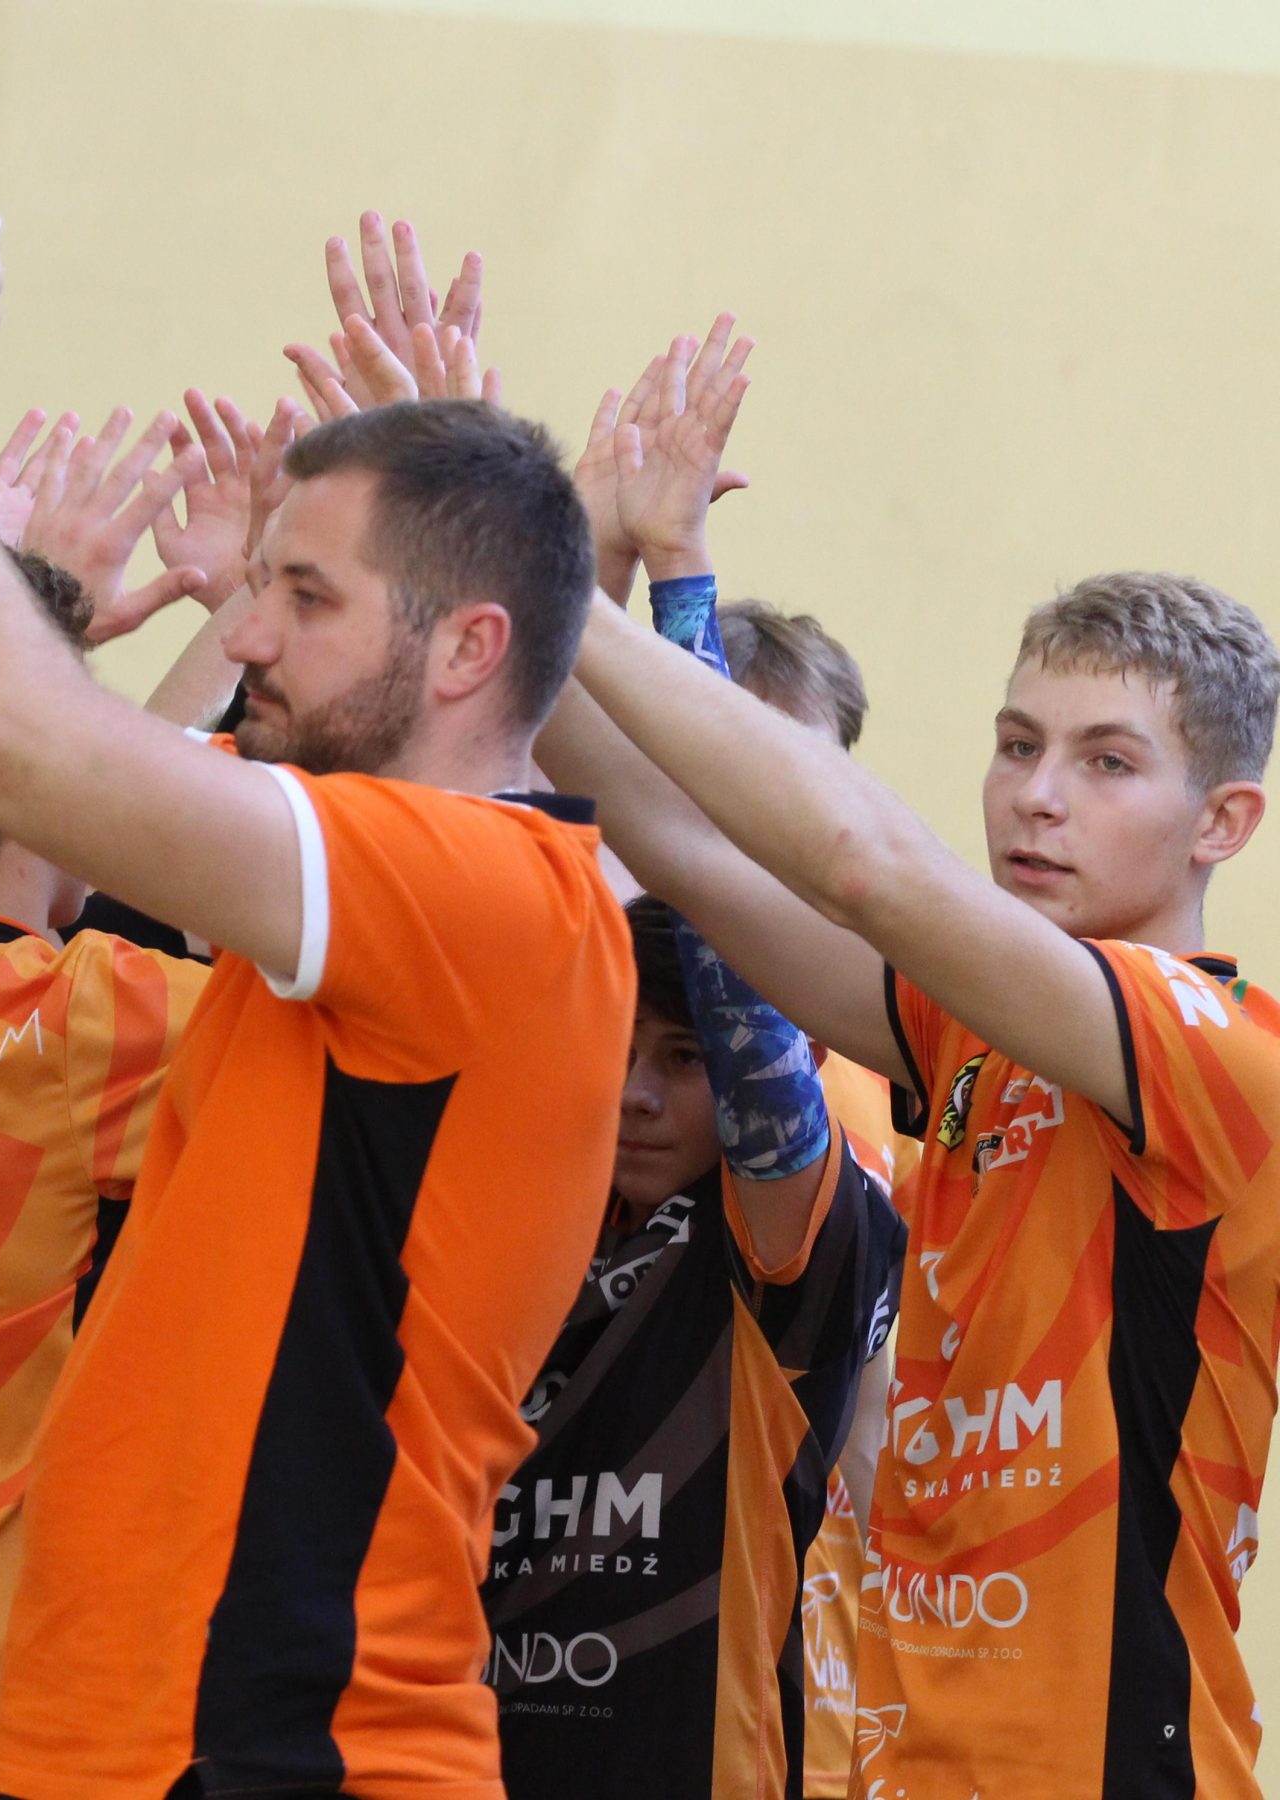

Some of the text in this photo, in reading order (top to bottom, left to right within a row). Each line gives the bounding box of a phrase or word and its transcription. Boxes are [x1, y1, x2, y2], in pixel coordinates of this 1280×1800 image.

[960, 1463, 1063, 1493] MIEDŹ
[550, 1553, 659, 1576] MIEDŹ
[480, 1631, 619, 1688] NDO
